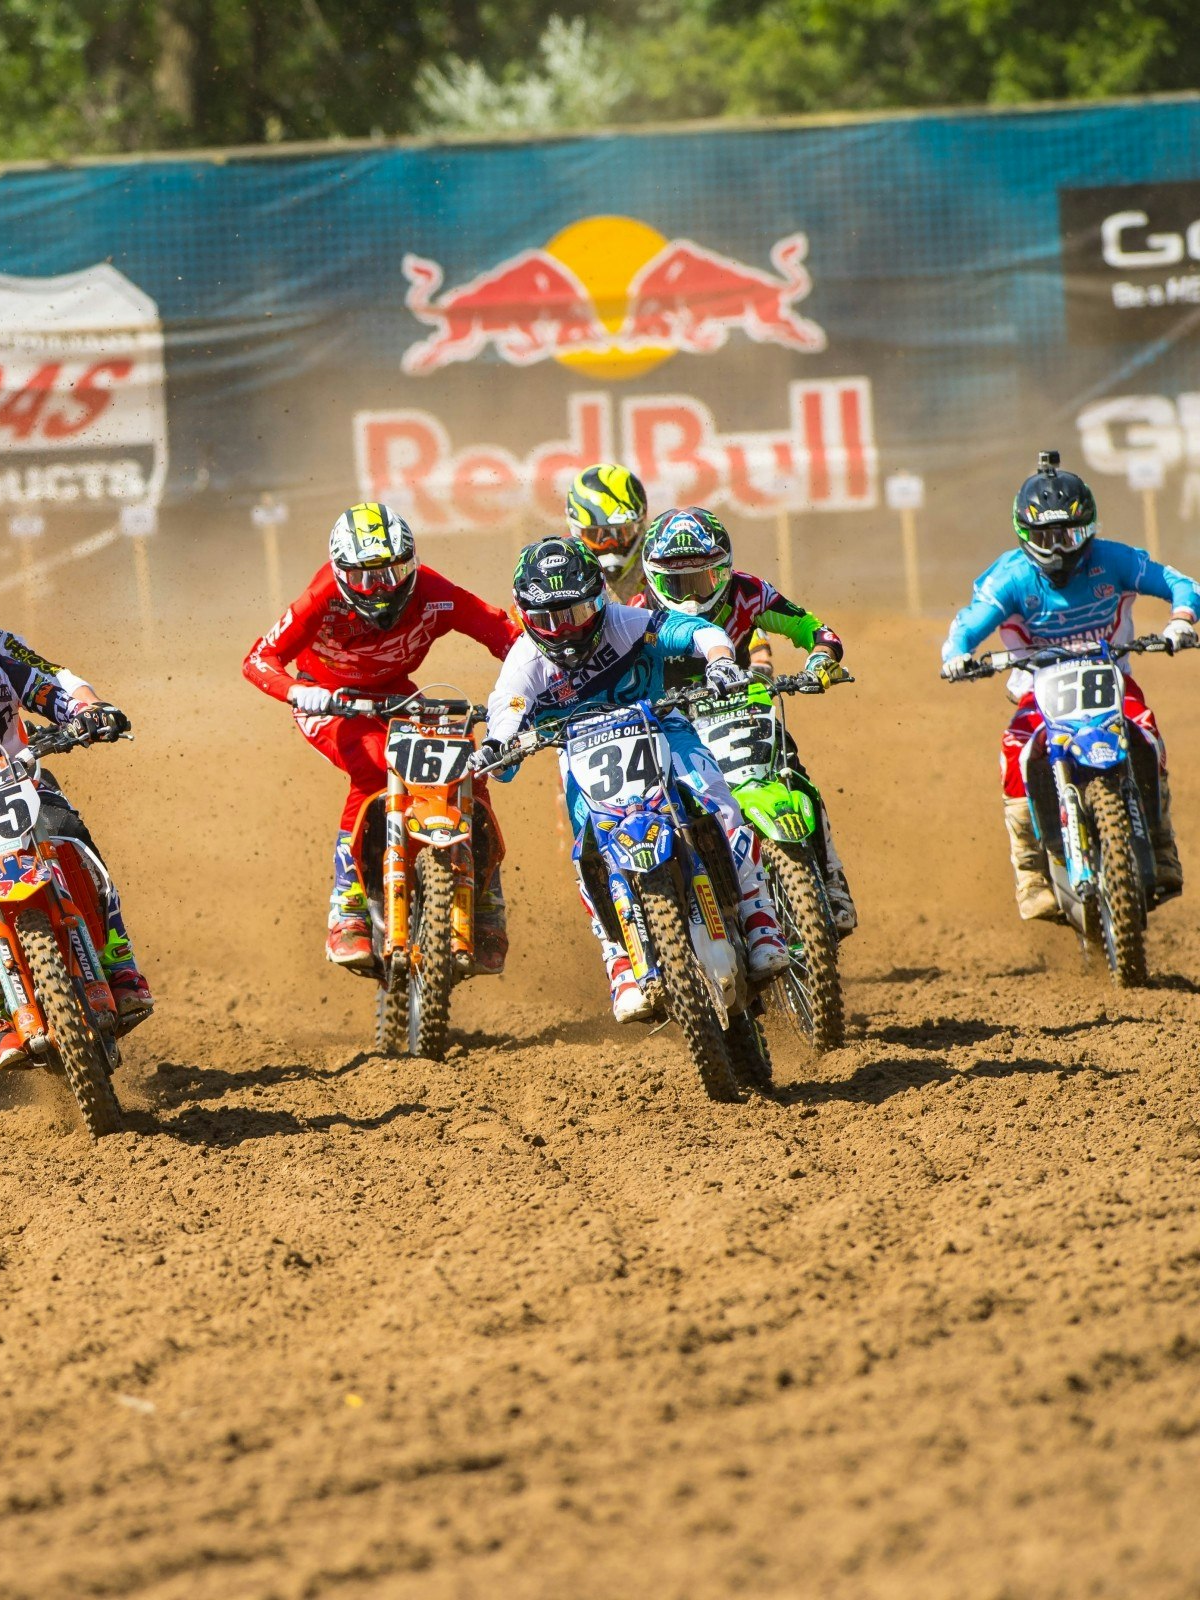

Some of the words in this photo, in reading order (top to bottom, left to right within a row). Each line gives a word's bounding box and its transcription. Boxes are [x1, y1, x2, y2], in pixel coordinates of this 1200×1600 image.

[352, 391, 612, 534] Red
[620, 375, 878, 518] Bull
[663, 546, 705, 555] MONSTER
[541, 555, 566, 569] Arai
[551, 589, 581, 597] TOYOTA
[1080, 659, 1093, 667] OIL
[1045, 669, 1116, 718] 68
[710, 711, 736, 726] LUCAS
[736, 708, 750, 717] OIL
[436, 726, 451, 735] OIL
[587, 729, 622, 748] LUCAS
[623, 725, 642, 737] OIL
[708, 718, 773, 774] 3
[387, 738, 476, 784] 167
[588, 736, 660, 803] 34
[628, 842, 656, 854] YAMAHA
[696, 884, 727, 941] PIRELLI
